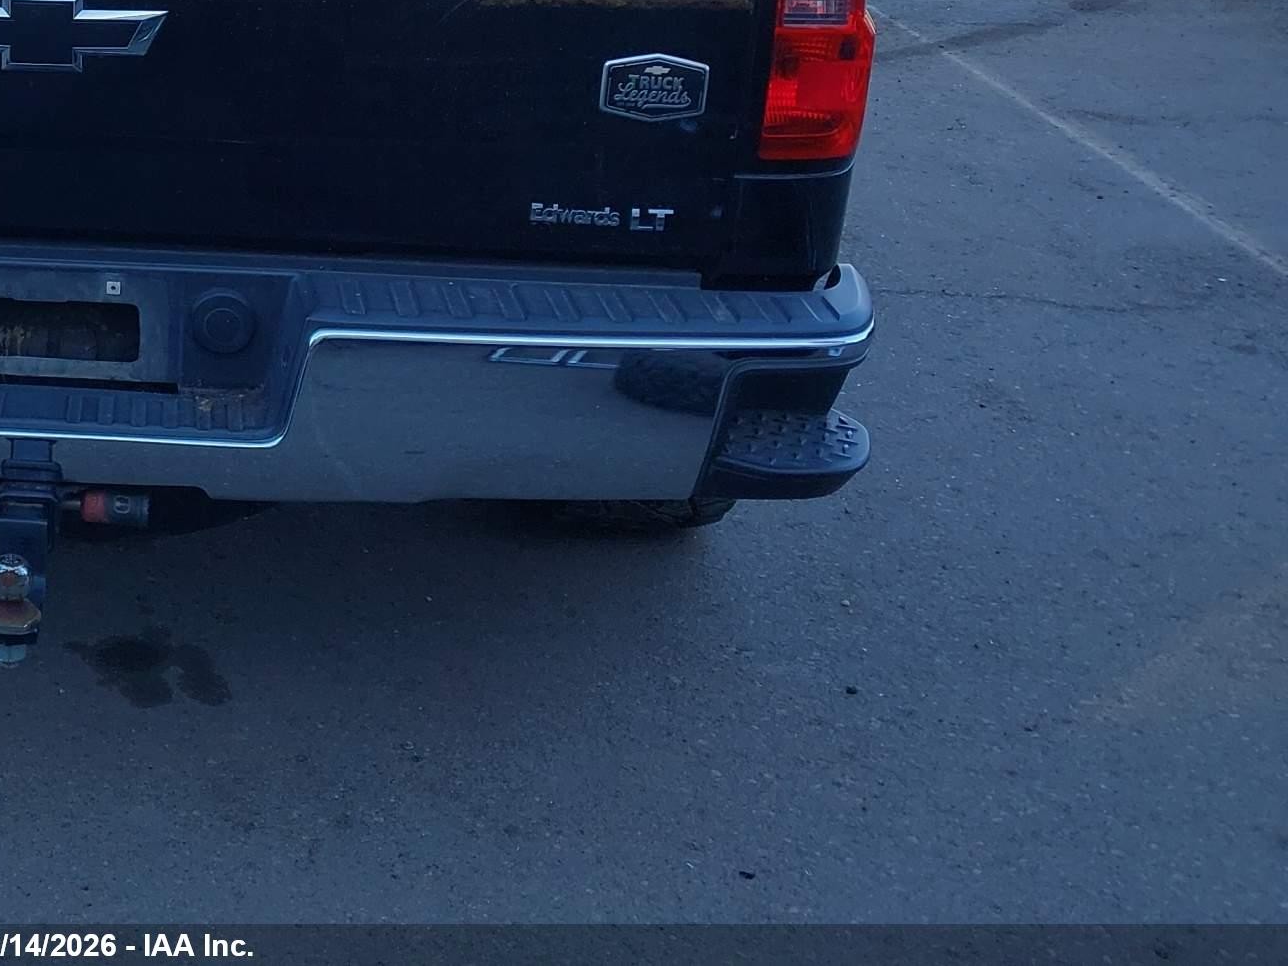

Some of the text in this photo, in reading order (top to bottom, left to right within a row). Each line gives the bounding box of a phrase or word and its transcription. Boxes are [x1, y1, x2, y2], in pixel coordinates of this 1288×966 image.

[628, 74, 684, 90] TRUCK
[614, 82, 691, 109] Legends
[630, 208, 674, 231] LT
